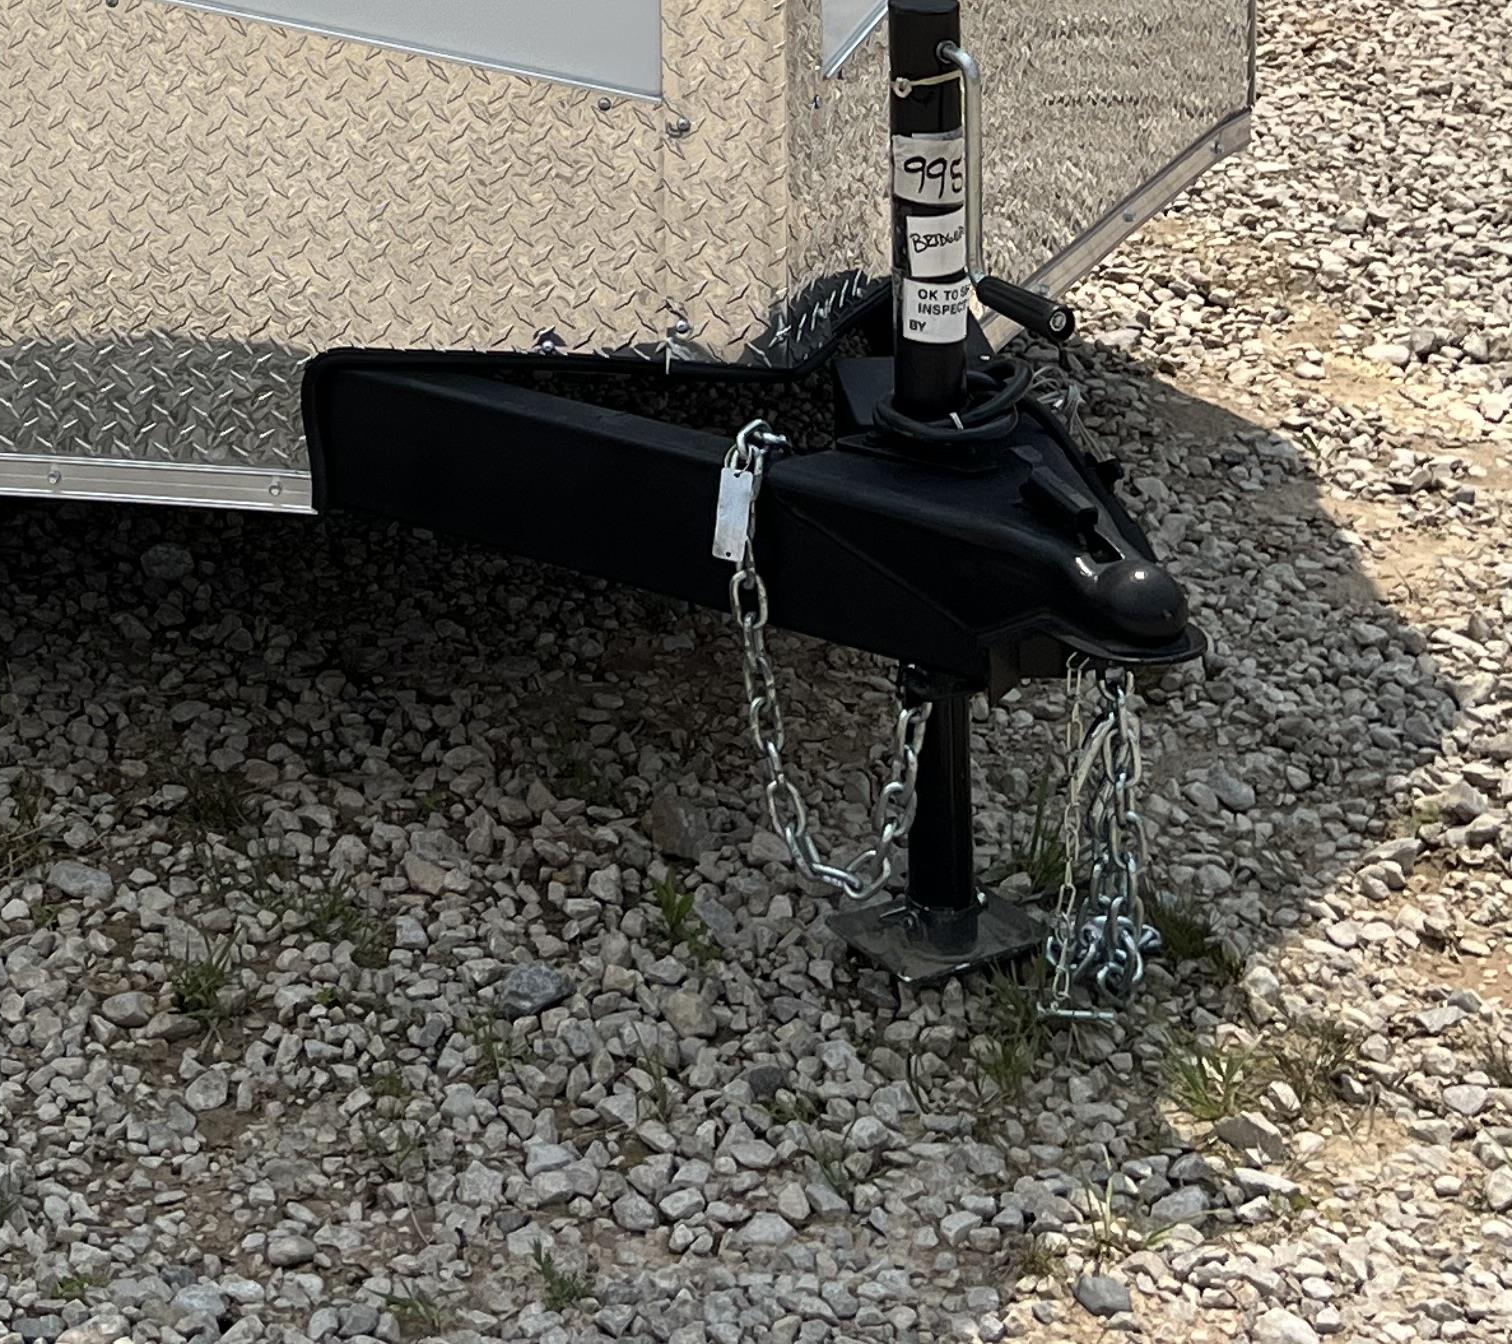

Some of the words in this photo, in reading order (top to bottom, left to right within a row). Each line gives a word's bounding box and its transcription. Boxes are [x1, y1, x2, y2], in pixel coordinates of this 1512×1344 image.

[917, 288, 938, 301] OK
[943, 289, 959, 301] TO
[908, 318, 927, 332] BY
